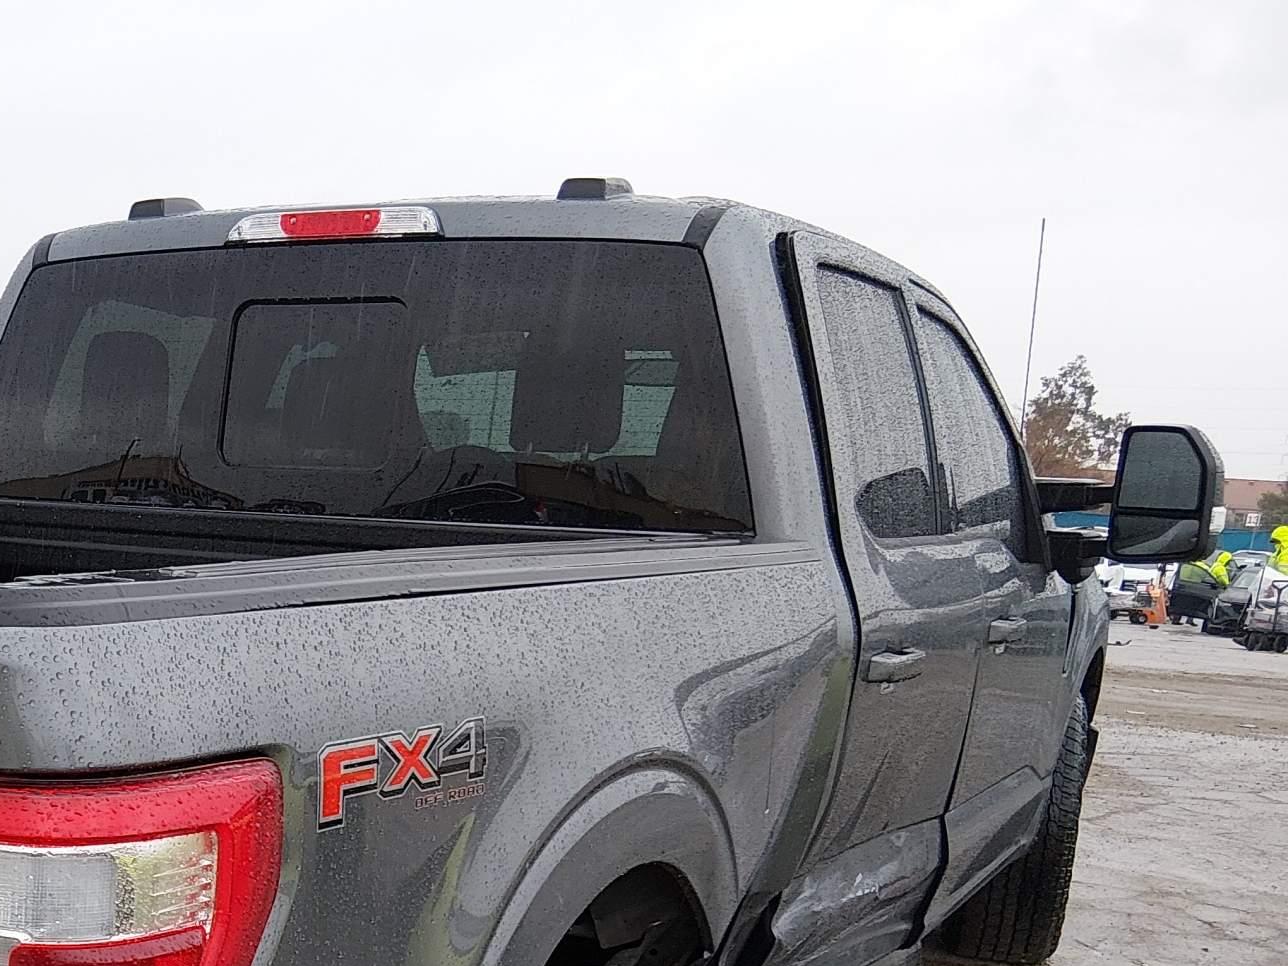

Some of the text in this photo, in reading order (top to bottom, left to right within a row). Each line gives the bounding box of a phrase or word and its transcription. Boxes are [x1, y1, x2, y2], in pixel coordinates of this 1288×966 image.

[317, 715, 488, 833] FX4
[414, 782, 485, 810] OFF ROAD
